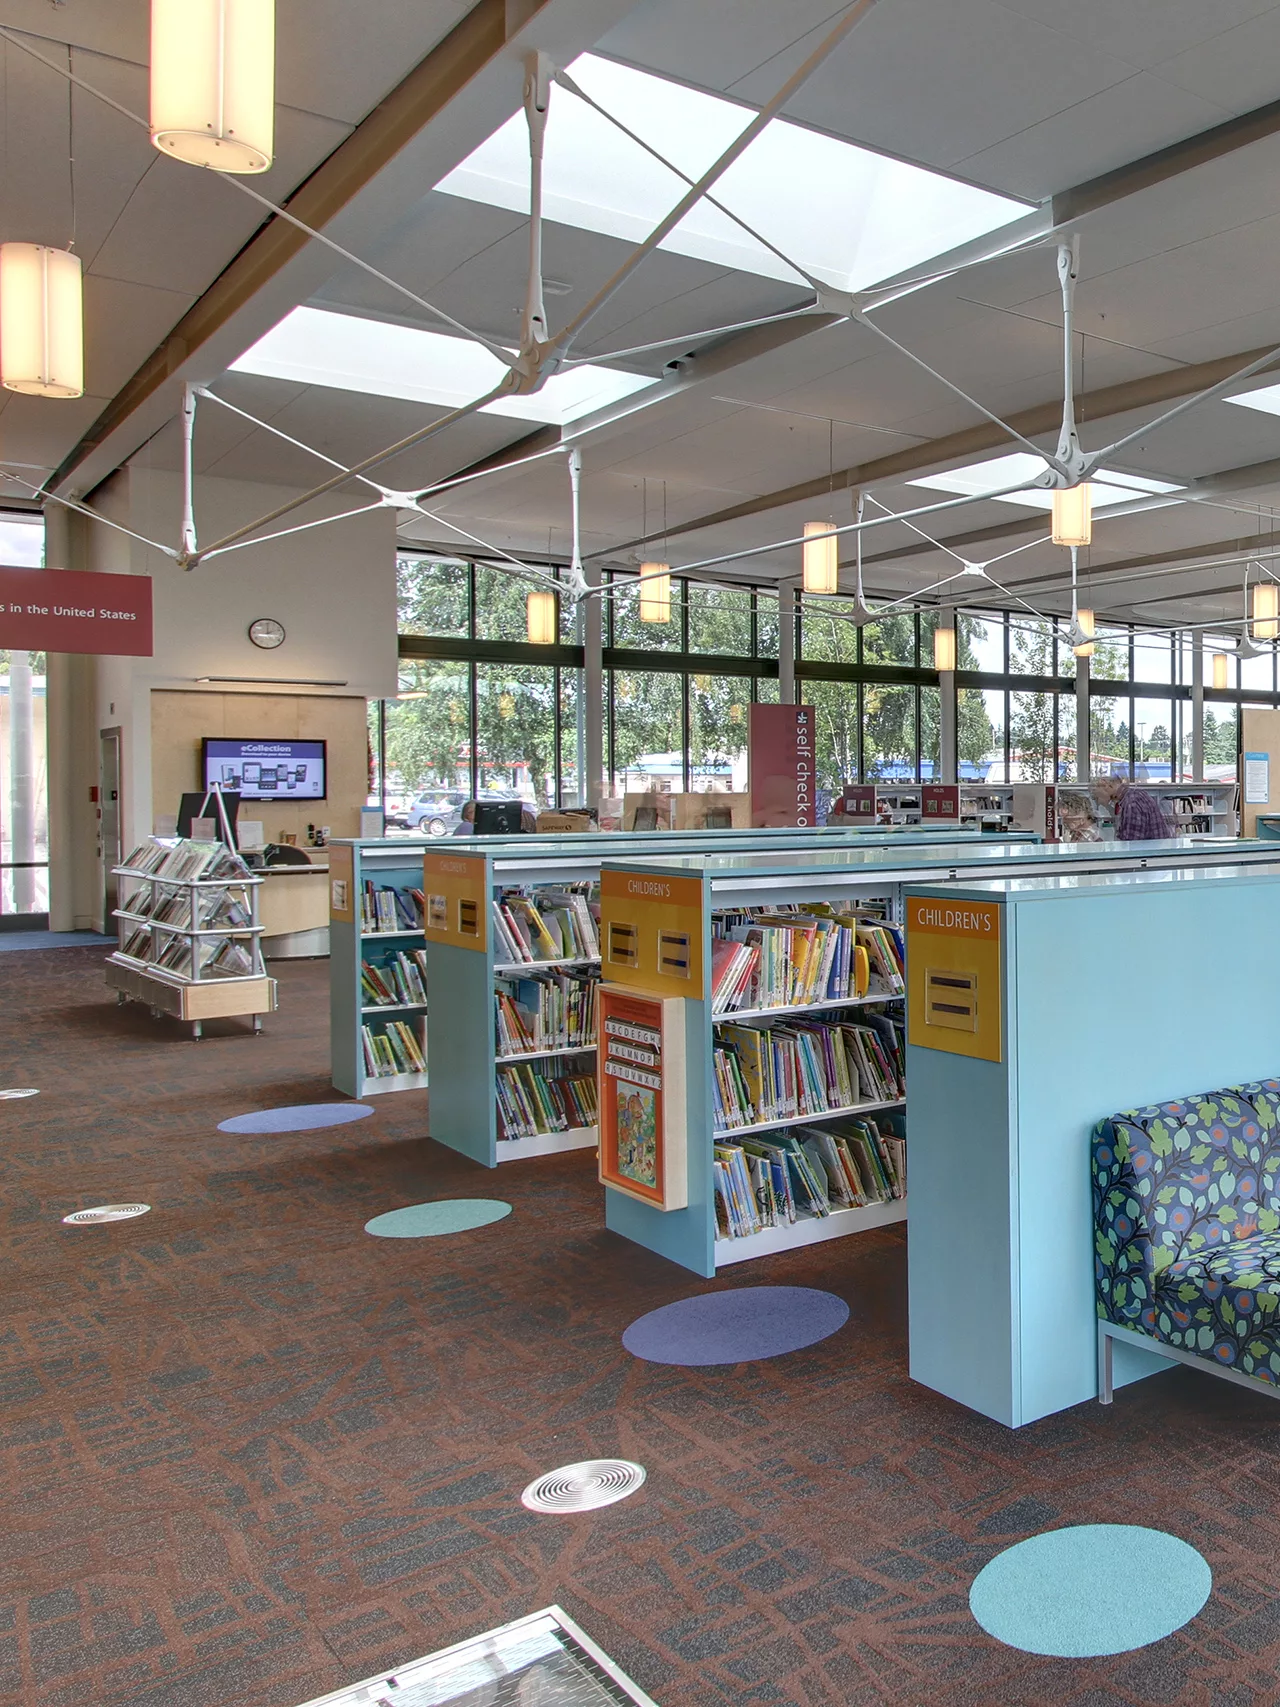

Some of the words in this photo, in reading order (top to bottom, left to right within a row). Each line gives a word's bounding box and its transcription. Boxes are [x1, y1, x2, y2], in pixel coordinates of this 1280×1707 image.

[10, 603, 22, 613] in
[27, 604, 49, 615] the
[53, 606, 95, 617] United
[99, 609, 137, 620] States
[240, 744, 291, 752] eCollection
[797, 727, 811, 758] self
[797, 762, 811, 812] check
[627, 880, 671, 897] CHILDREN'S
[917, 908, 991, 931] CHILDREN'S
